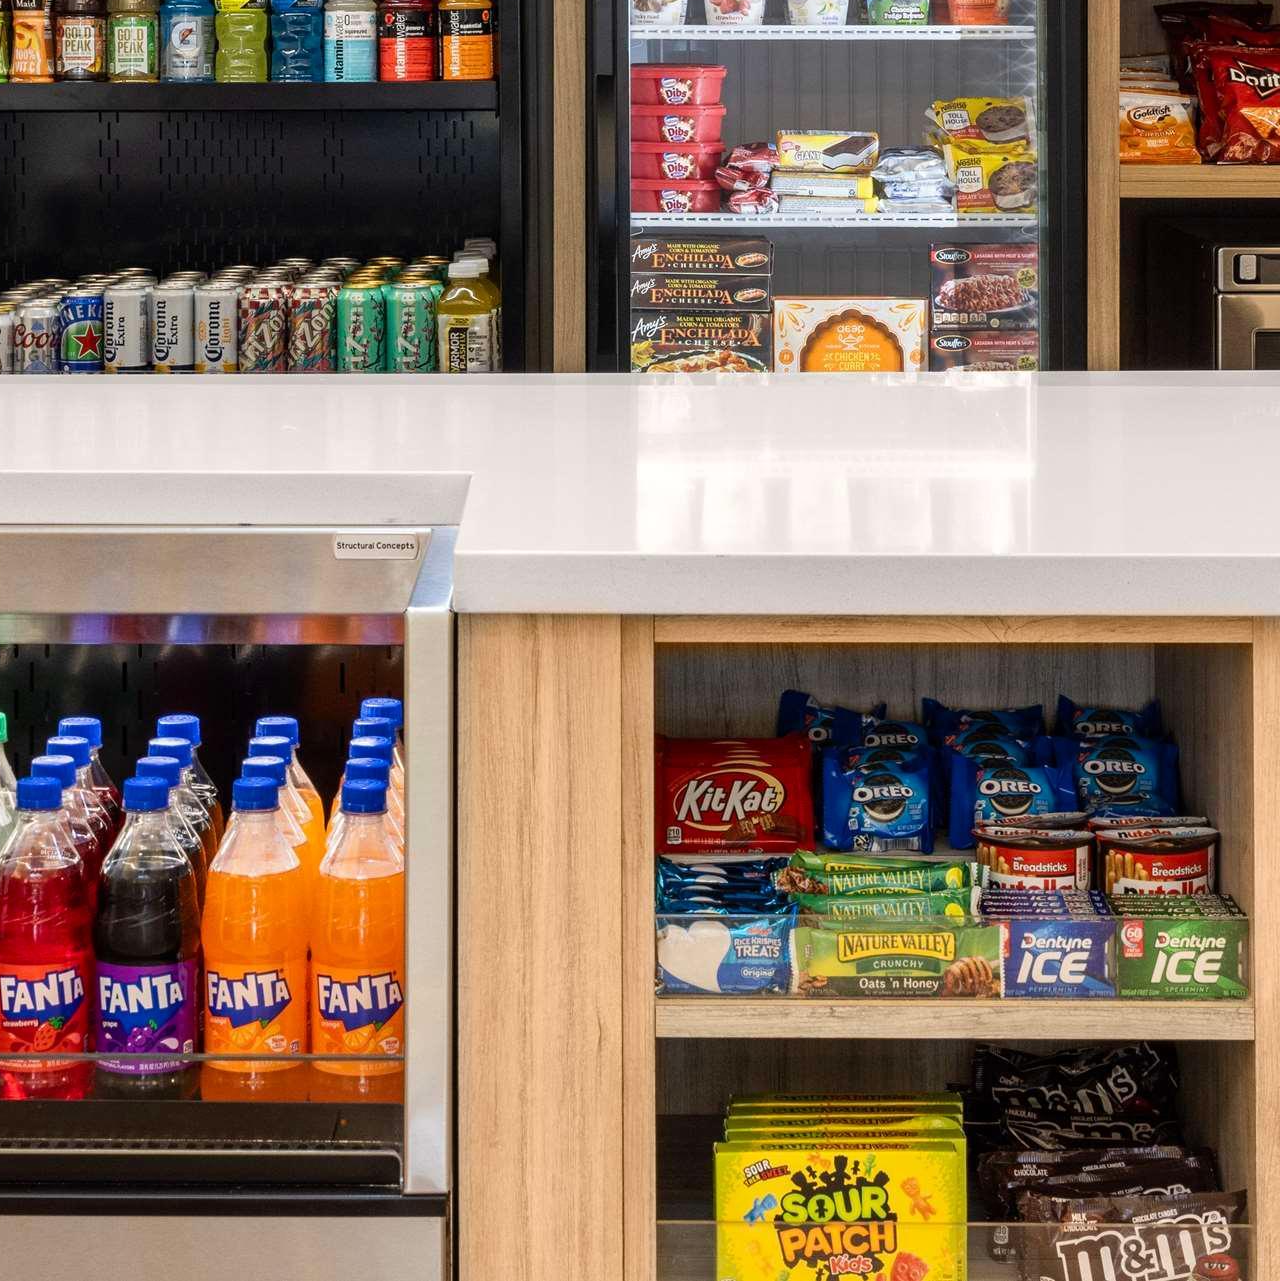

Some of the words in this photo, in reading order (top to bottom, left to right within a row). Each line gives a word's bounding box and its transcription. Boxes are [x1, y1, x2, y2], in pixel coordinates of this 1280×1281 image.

[64, 28, 91, 39] GOLD
[65, 40, 90, 52] PEAK
[117, 42, 143, 53] PEAK
[335, 11, 344, 80] vitaminwater
[666, 88, 686, 98] Dibs
[1133, 105, 1171, 120] Goldfish
[668, 126, 689, 136] Dibs
[795, 151, 820, 160] GIANT
[668, 162, 689, 172] Dibs
[632, 244, 658, 263] Amy's
[939, 251, 967, 262] Stouffer's
[651, 254, 735, 269] ENCHILADA
[631, 279, 655, 296] Amy's
[650, 289, 734, 304] ENCHILADA
[105, 301, 117, 363] Corona
[116, 317, 125, 347] Extra
[170, 316, 178, 345] Extra
[659, 329, 761, 346] ENCHILADA
[835, 353, 869, 361] CHICKEN
[839, 362, 865, 371] CURRY
[377, 542, 414, 550] Concepts
[1084, 760, 1145, 774] OREO
[853, 784, 914, 802] OREO
[980, 780, 1041, 794] OREO
[677, 780, 778, 821] KitKat
[668, 828, 680, 836] 210
[994, 829, 1050, 838] nutella
[1118, 829, 1171, 839] nutella
[1013, 860, 1068, 872] Breadsticks
[1152, 864, 1201, 876] Breadsticks
[832, 872, 872, 893] NATURE
[874, 870, 924, 886] VALLEY
[1127, 929, 1142, 939] 60
[1155, 932, 1226, 950] Dentyne
[842, 935, 894, 956] NATURE
[895, 935, 952, 955] VALLEY
[1021, 933, 1092, 951] Dentyne
[736, 947, 780, 957] TREATS
[873, 960, 923, 968] CRUNCHY
[1017, 952, 1089, 983] ICE
[1151, 951, 1223, 983] ICE
[741, 968, 774, 978] Original
[0, 970, 84, 1013] FANTA
[859, 978, 886, 989] Oats
[903, 978, 939, 991] Honey
[99, 974, 184, 1013] FANTA
[208, 973, 289, 1012] FANTA
[318, 974, 402, 1013] FANTA
[2, 1020, 39, 1028] strawberry
[103, 1020, 118, 1028] grape
[744, 1160, 770, 1178] SOUR
[1014, 1169, 1048, 1177] CHOCOLATE
[781, 1186, 887, 1224] SOUR
[1158, 1209, 1177, 1220] CANDIES
[779, 1223, 895, 1261] PATCH
[829, 1254, 873, 1274] Kids
